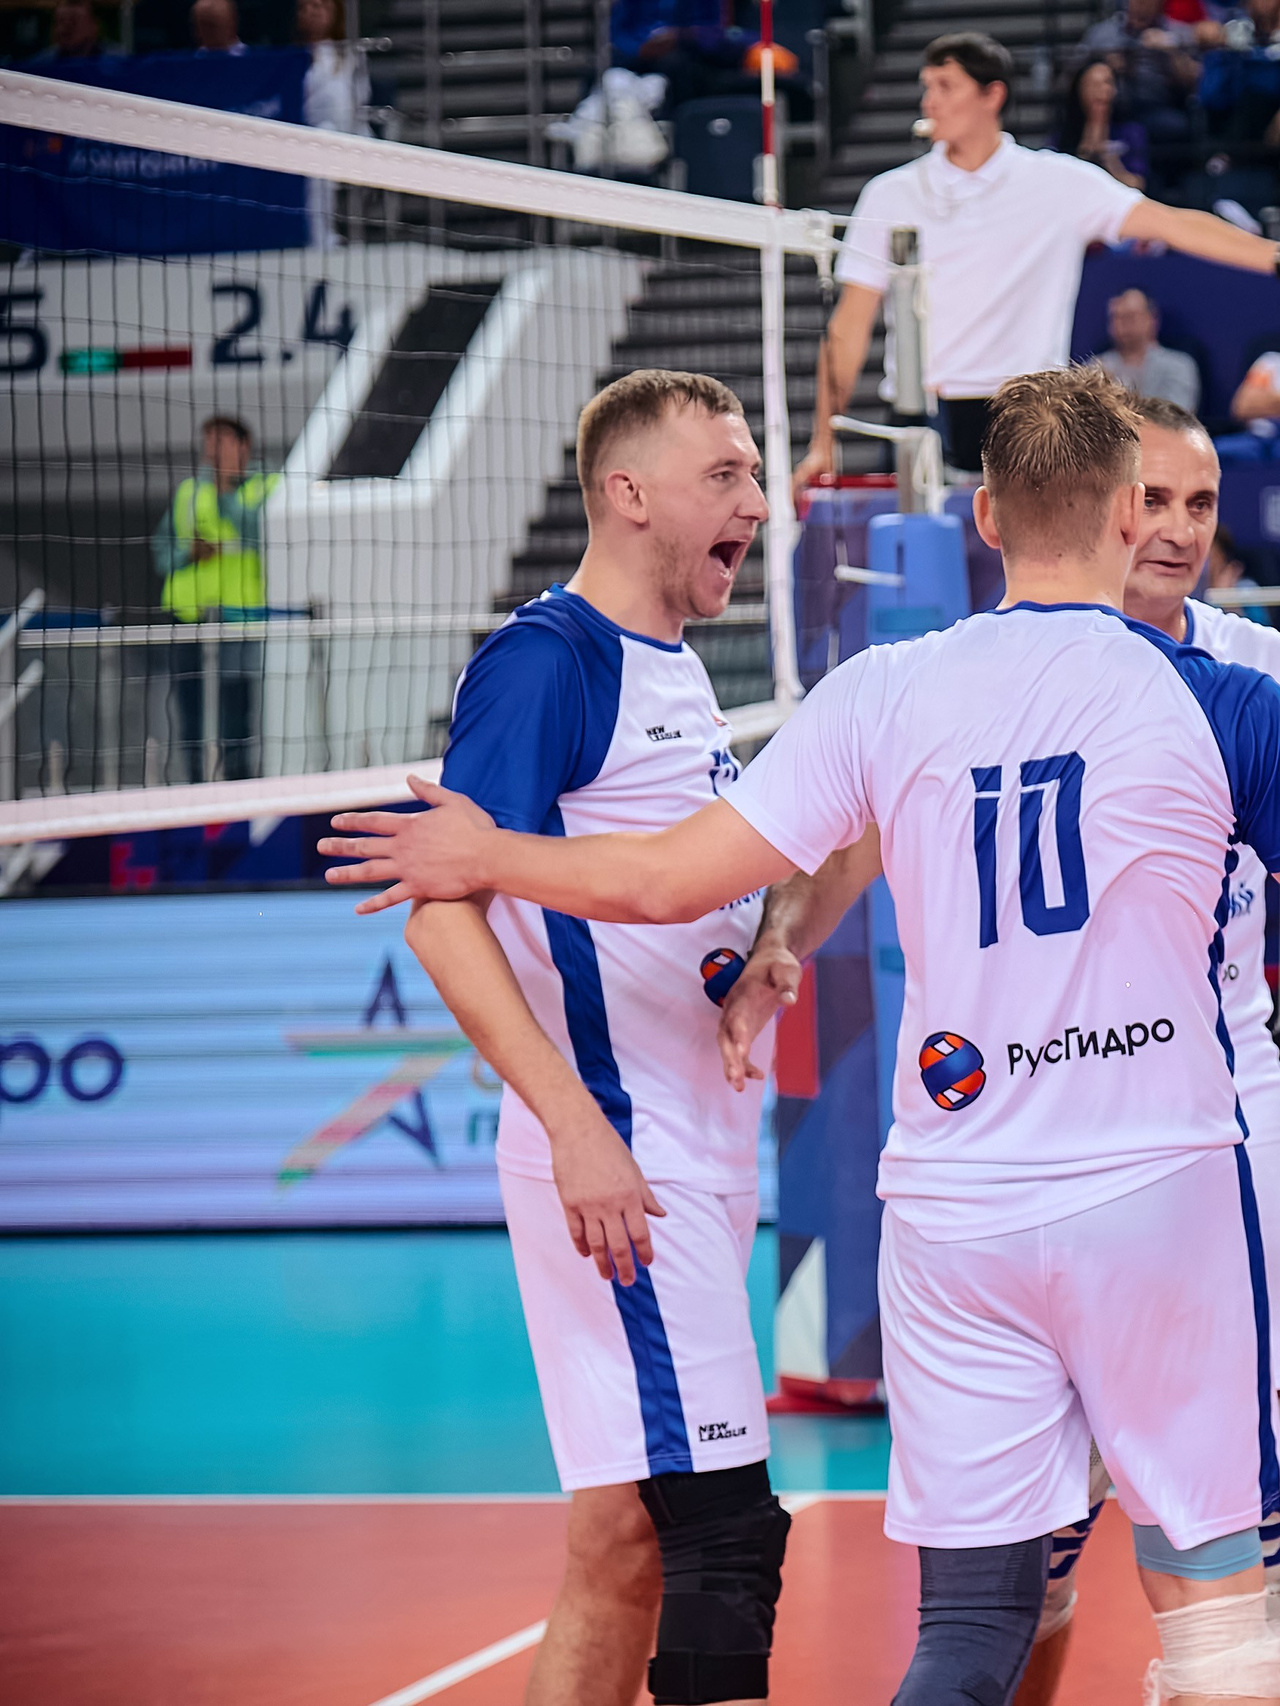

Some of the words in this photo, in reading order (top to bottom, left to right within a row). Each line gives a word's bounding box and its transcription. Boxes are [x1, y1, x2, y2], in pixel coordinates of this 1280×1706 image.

[970, 751, 1091, 949] 10
[1007, 1018, 1175, 1078] РусГидро
[699, 1421, 728, 1433] NEW
[699, 1426, 747, 1442] LEAGUE
